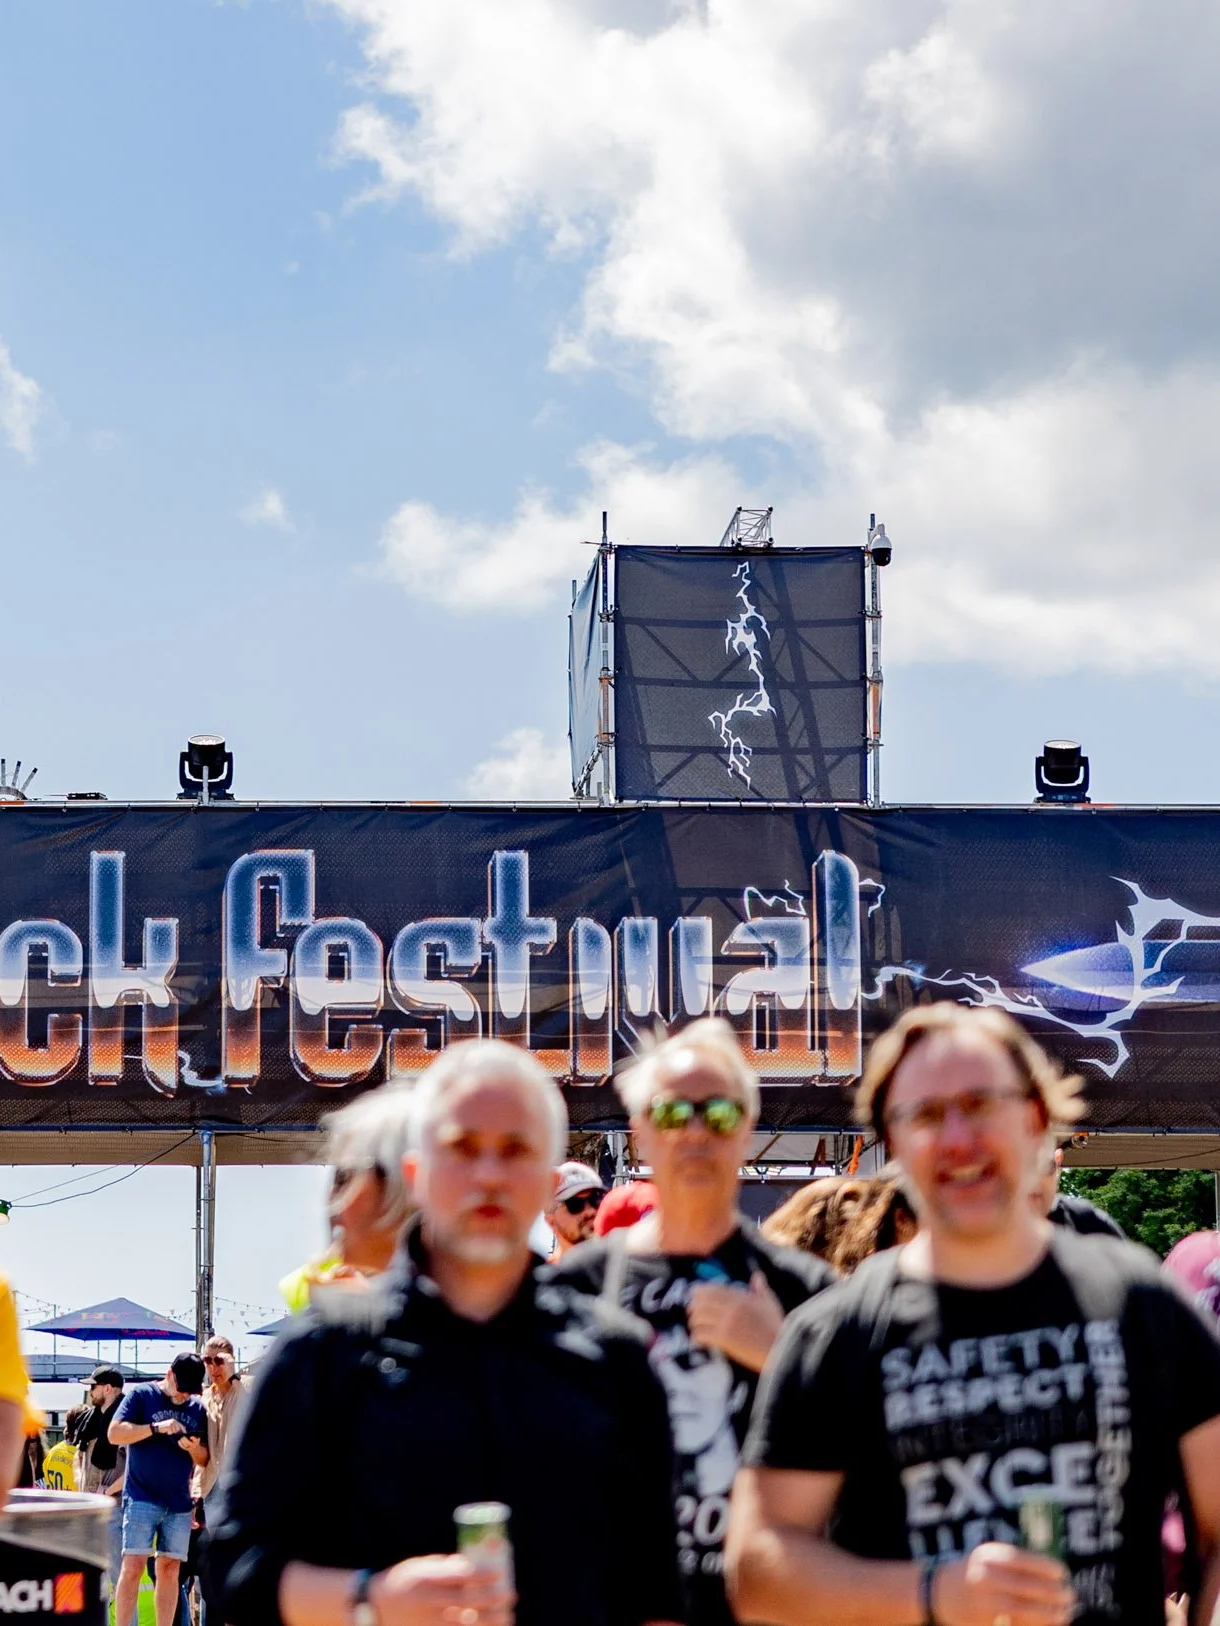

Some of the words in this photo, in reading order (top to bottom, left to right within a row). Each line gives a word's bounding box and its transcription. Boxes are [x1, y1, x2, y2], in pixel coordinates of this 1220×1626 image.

[222, 849, 863, 1087] Festival
[881, 1322, 1080, 1392] SAFETY
[884, 1362, 1088, 1434] RESPECT
